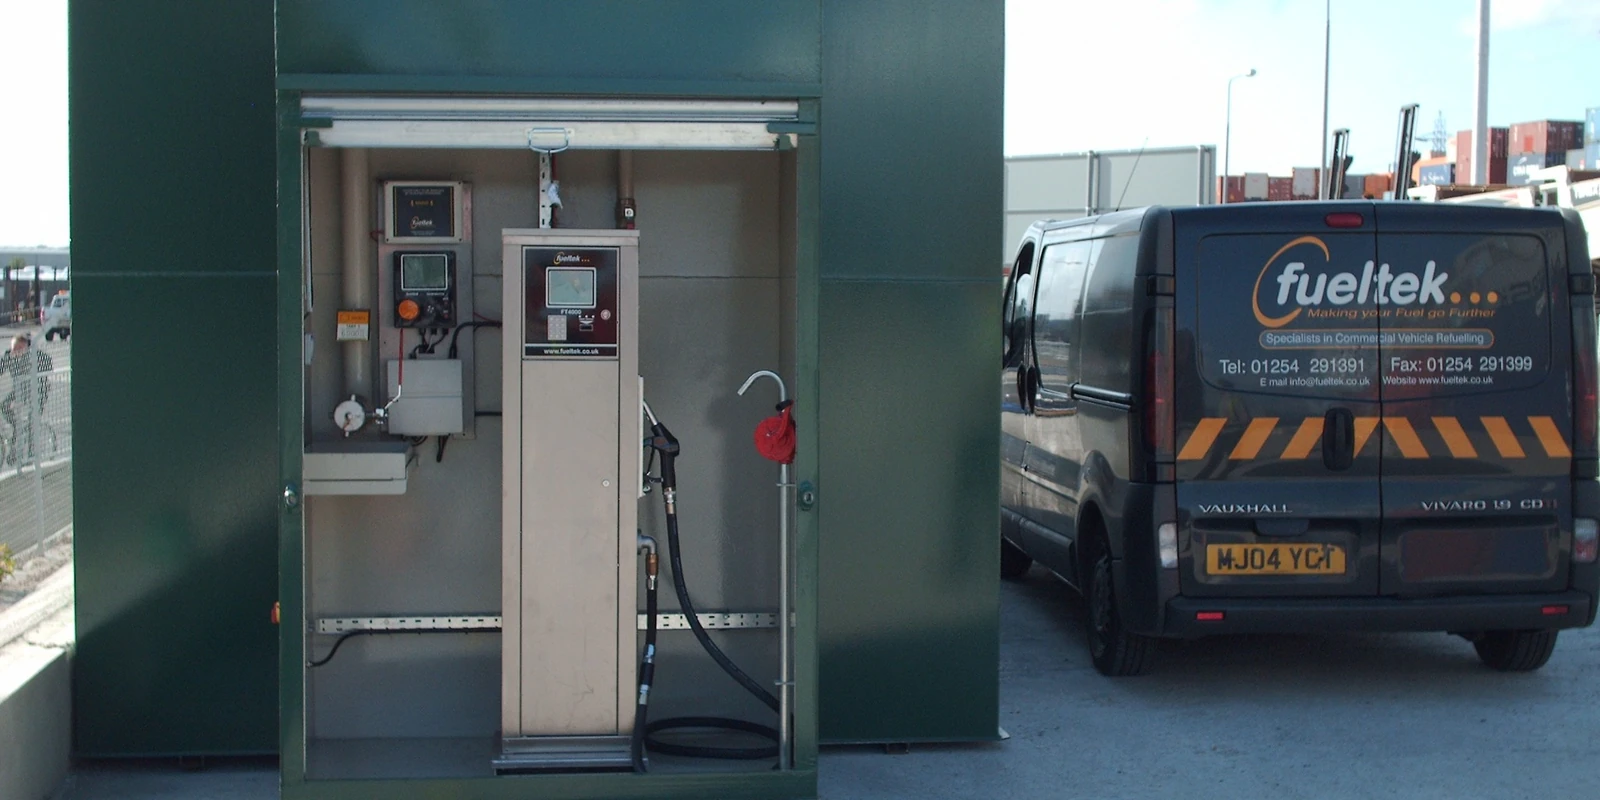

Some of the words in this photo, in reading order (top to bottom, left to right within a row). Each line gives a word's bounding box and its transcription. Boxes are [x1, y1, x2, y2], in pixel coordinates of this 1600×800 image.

[1307, 307, 1358, 320] Making
[1362, 310, 1391, 320] your
[1395, 307, 1425, 318] Fuel
[1428, 310, 1446, 320] go
[1449, 307, 1496, 318] Further
[1266, 331, 1321, 345] Specialists
[1324, 332, 1333, 344] in
[1335, 331, 1396, 344] Commercial
[1398, 331, 1434, 343] Vehicle
[1436, 330, 1484, 345] Refuelling
[1219, 358, 1246, 374] Tel:
[1251, 358, 1299, 374] 01254
[1310, 357, 1365, 373] 291391
[1391, 356, 1423, 372] Fax:
[1427, 356, 1473, 372] 01254
[1479, 355, 1533, 371] 291399
[1260, 377, 1266, 386] E
[1269, 376, 1287, 386] mail
[1289, 375, 1370, 387] info@fueltek.co.uk
[1382, 375, 1417, 386] Website
[1418, 374, 1494, 386] www.fueltek.co.uk
[1199, 503, 1292, 513] VAUXHALL
[1421, 499, 1486, 511] VIVARO
[1217, 547, 1281, 570] MJ04
